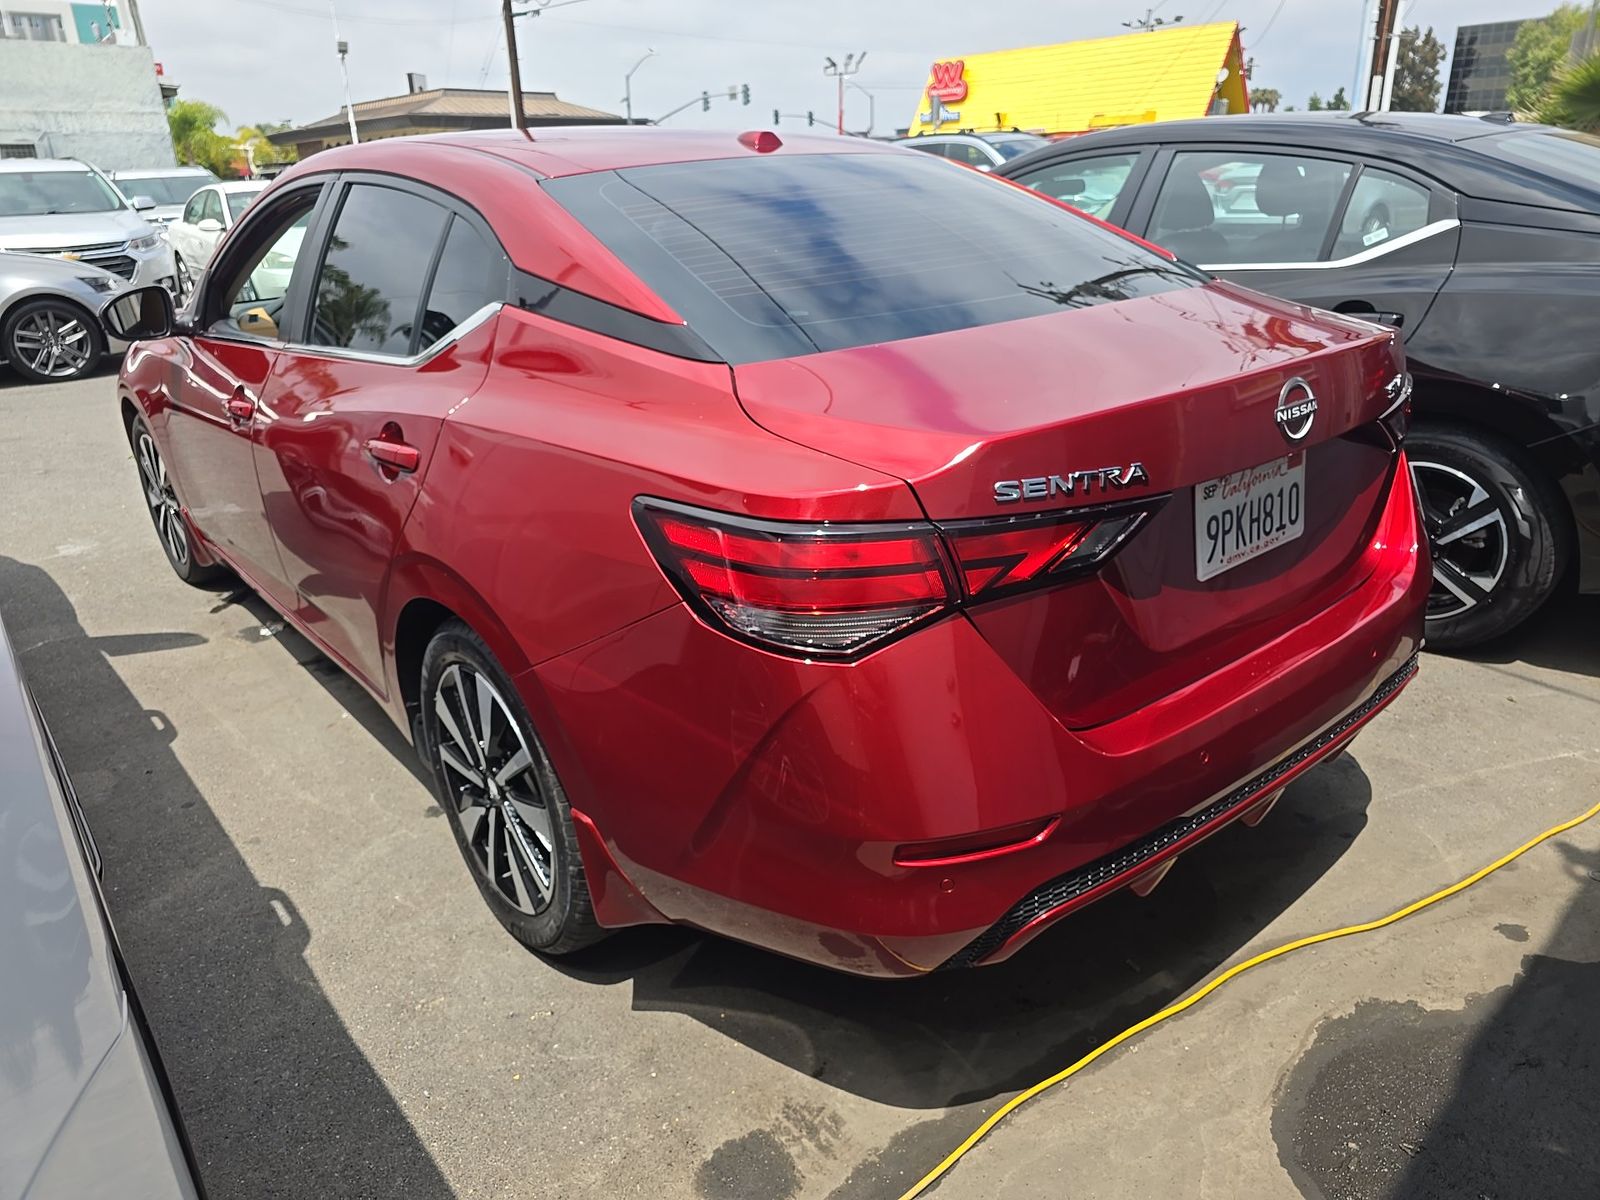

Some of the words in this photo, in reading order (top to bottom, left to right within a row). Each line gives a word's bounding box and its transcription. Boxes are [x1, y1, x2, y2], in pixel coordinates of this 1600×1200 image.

[1276, 399, 1318, 422] NISSAN
[994, 462, 1149, 502] SENTRA
[1203, 484, 1217, 500] SEP
[1221, 463, 1288, 500] California
[1206, 482, 1300, 564] 9PKH810
